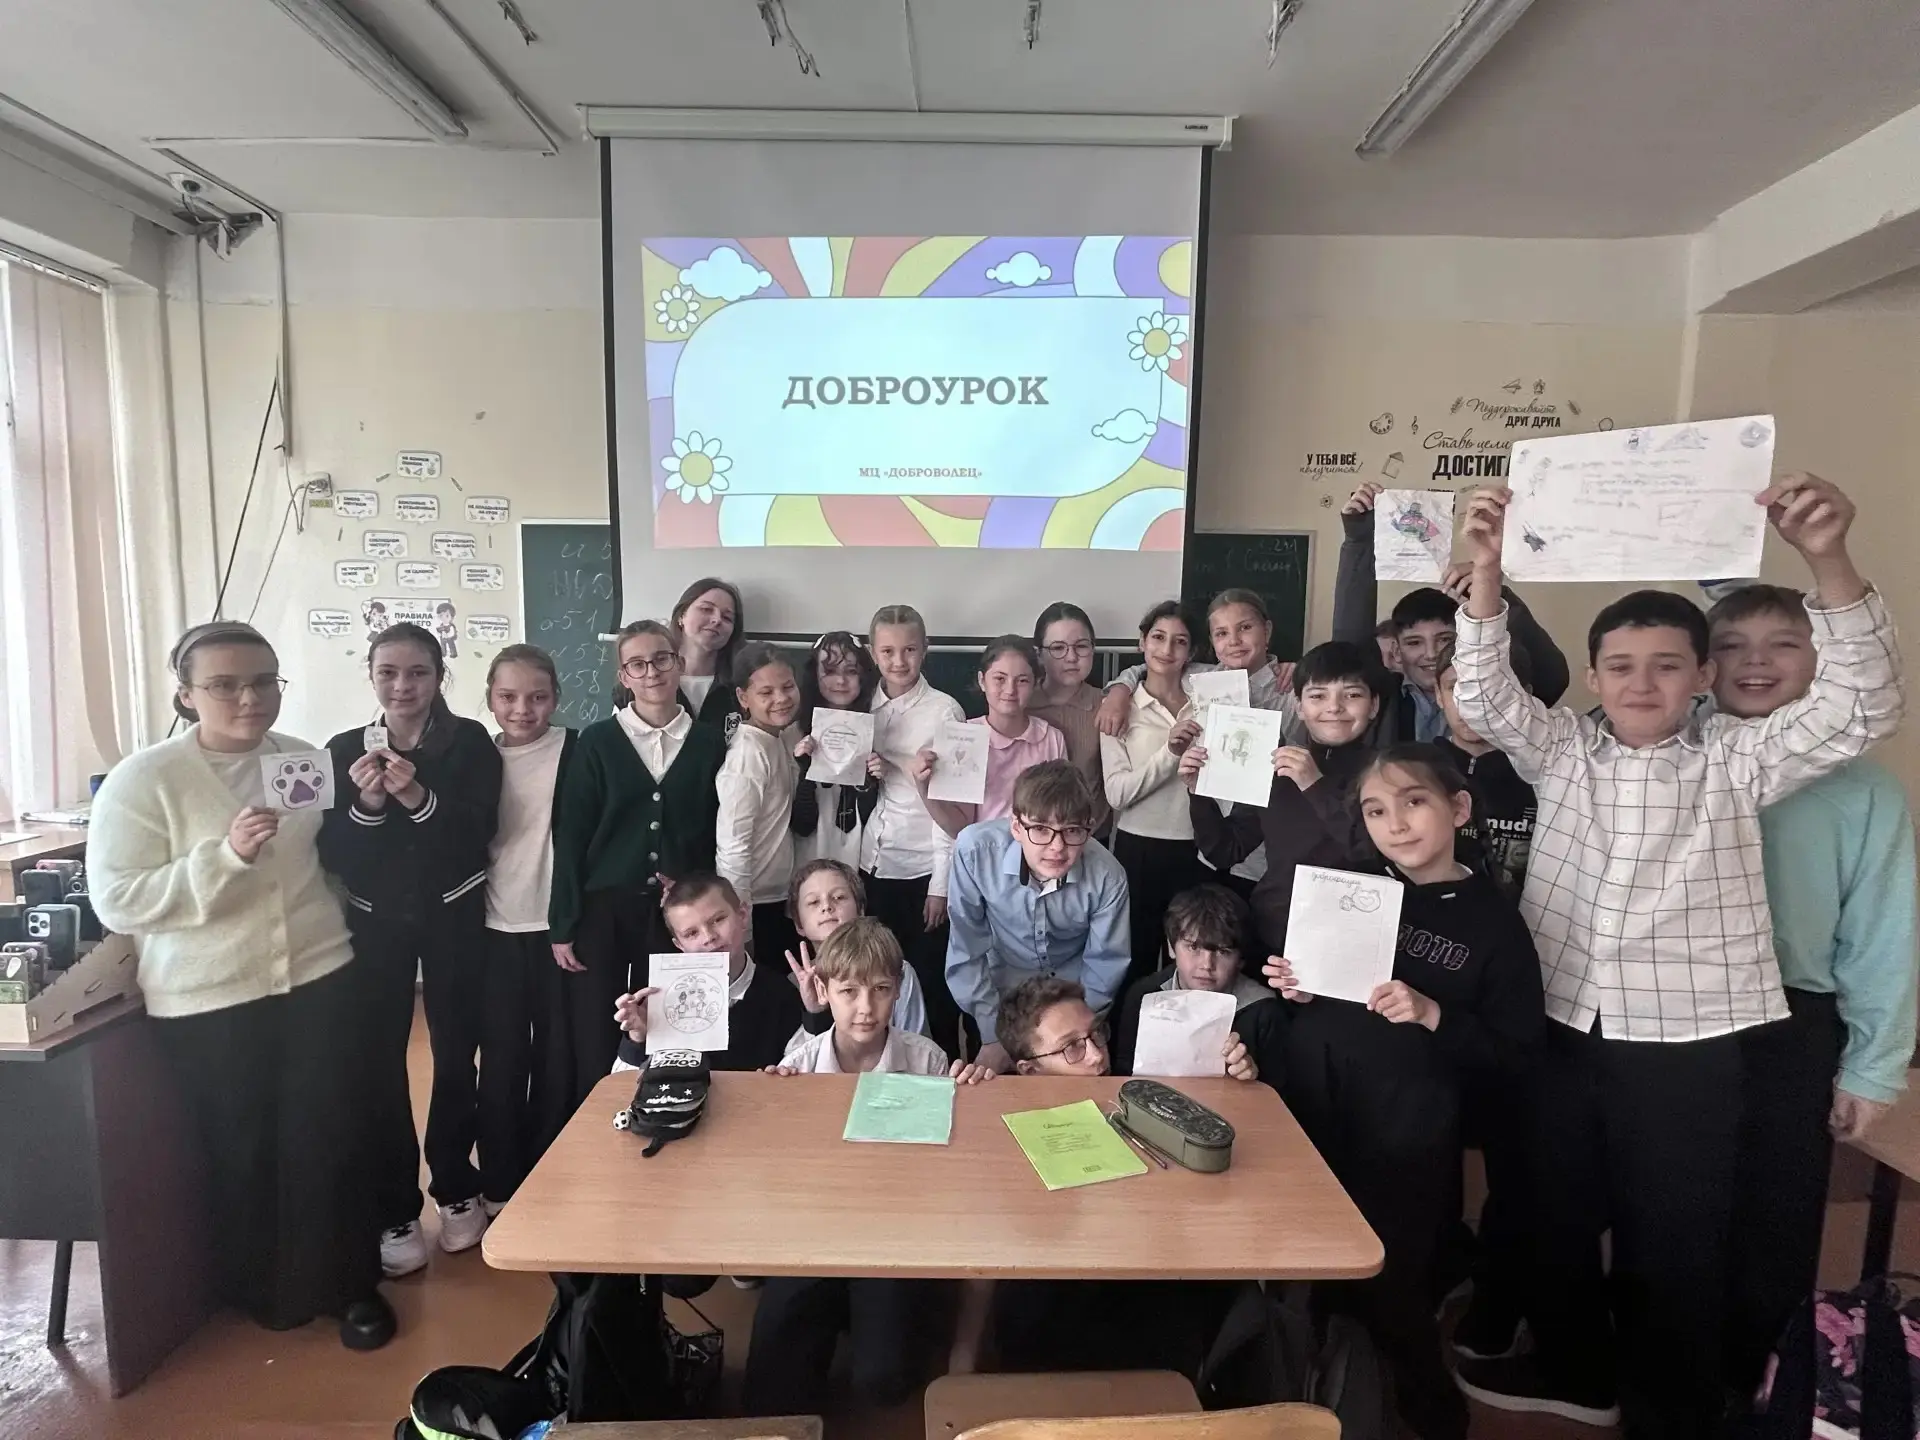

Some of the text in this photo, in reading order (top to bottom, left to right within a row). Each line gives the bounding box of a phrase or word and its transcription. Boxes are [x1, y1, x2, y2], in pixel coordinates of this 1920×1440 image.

[782, 376, 1049, 409] ДОБРОУРОК
[1505, 415, 1561, 429] ДРУГ ДРУГА
[1423, 428, 1512, 453] Ставь цели
[1307, 451, 1357, 466] У ТЕБЯ ВСЁ
[859, 467, 982, 479] МЦ «ДОБРОВОЛЕЦ»
[394, 612, 433, 620] ПРАВИЛА
